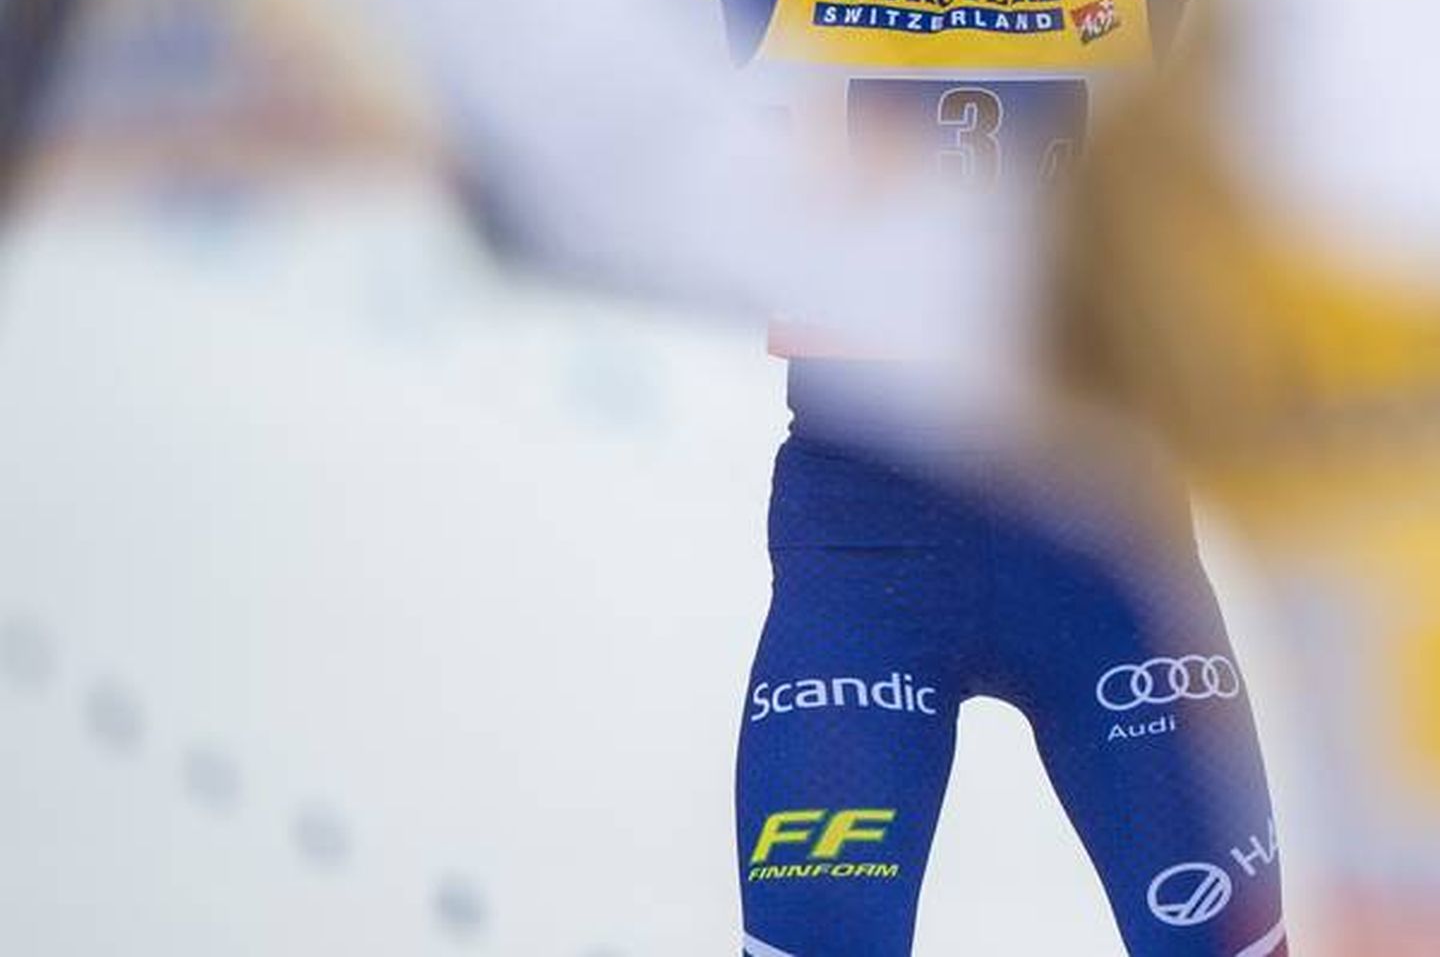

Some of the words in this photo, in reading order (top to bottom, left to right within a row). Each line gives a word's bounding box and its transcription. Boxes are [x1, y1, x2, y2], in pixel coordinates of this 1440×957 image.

[823, 6, 1052, 32] SWITZERLAND
[937, 86, 1004, 198] 3
[751, 672, 937, 722] Scandic
[1107, 715, 1177, 741] Audi
[752, 808, 897, 863] FF
[749, 863, 900, 881] FINNFORM
